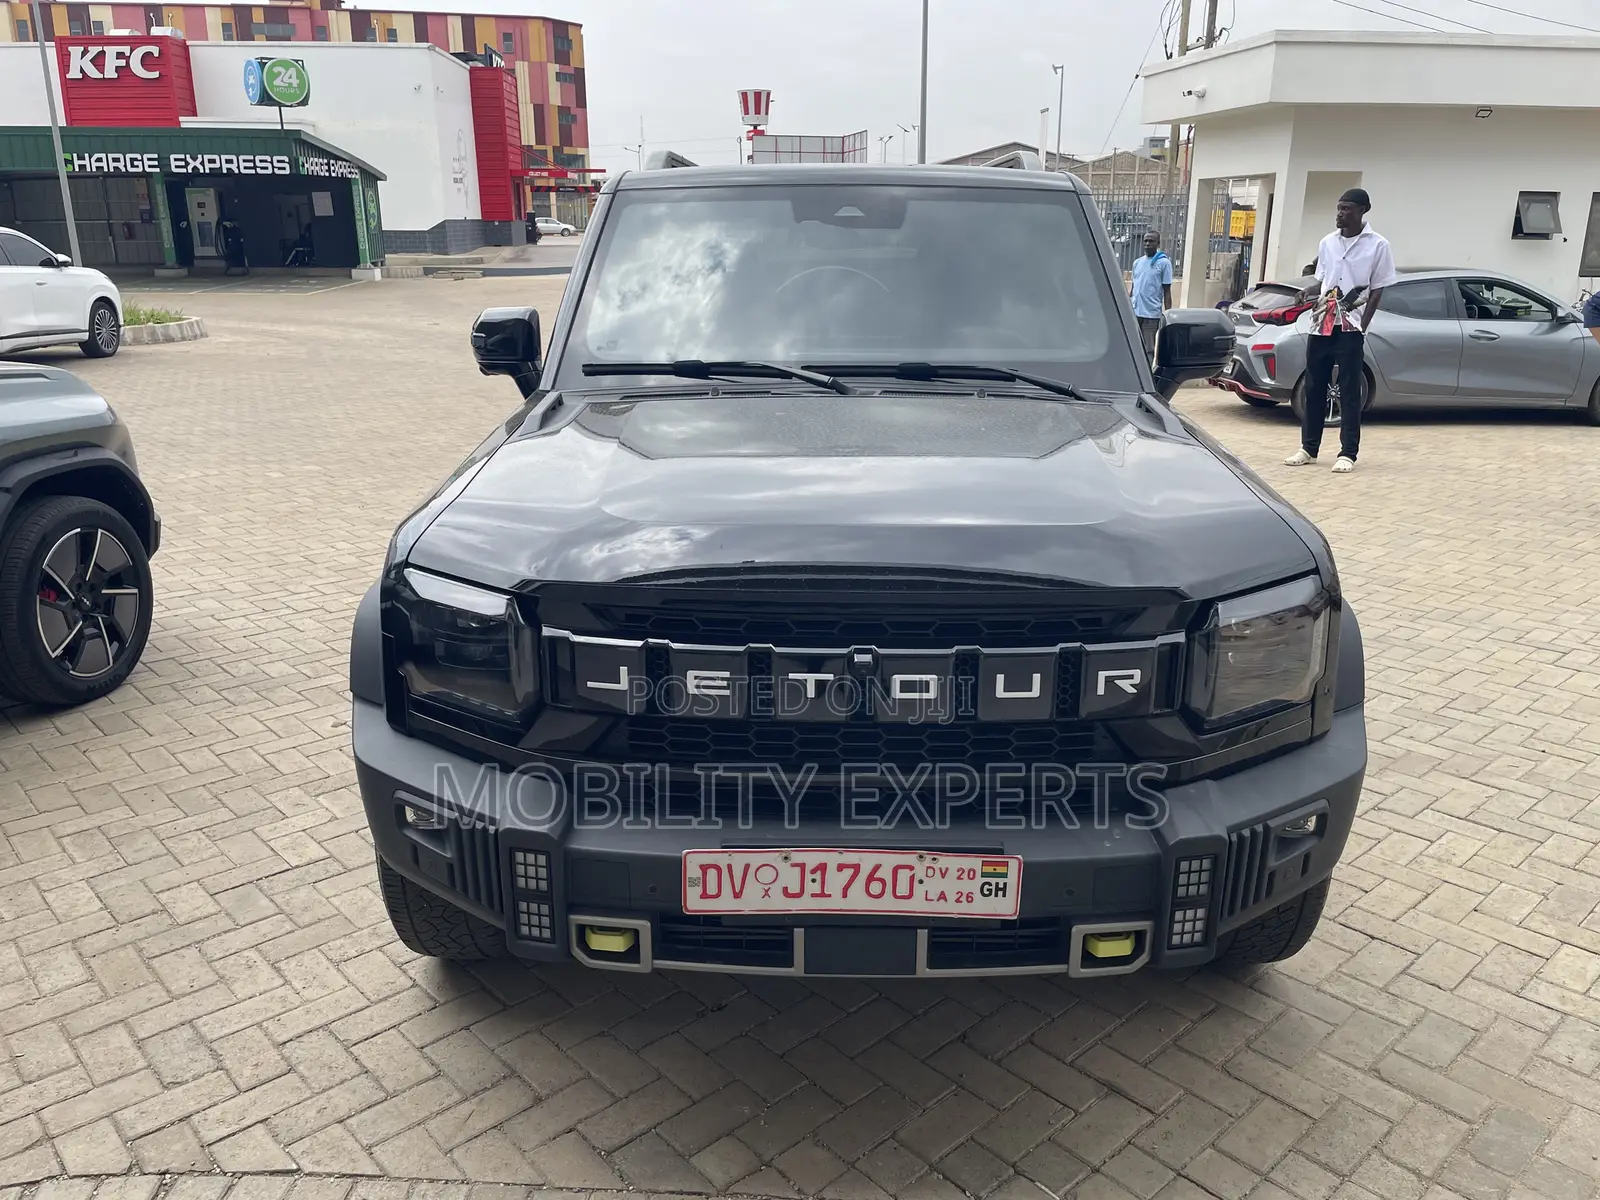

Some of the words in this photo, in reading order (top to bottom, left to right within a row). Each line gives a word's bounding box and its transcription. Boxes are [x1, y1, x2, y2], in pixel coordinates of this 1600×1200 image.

[66, 45, 160, 79] KFC
[272, 66, 300, 88] 24
[273, 86, 300, 94] HOURS
[63, 153, 160, 173] CHARGE
[170, 154, 291, 175] EXPRESS
[299, 156, 329, 177] CHARGE
[330, 159, 359, 179] EXPRESS
[586, 666, 1141, 699] JETOUR
[699, 863, 751, 899] DV
[782, 862, 916, 900] J1760
[924, 865, 950, 880] DV
[956, 867, 977, 881] 20
[924, 889, 949, 903] LA
[955, 890, 975, 904] 26
[979, 881, 1008, 899] GH
